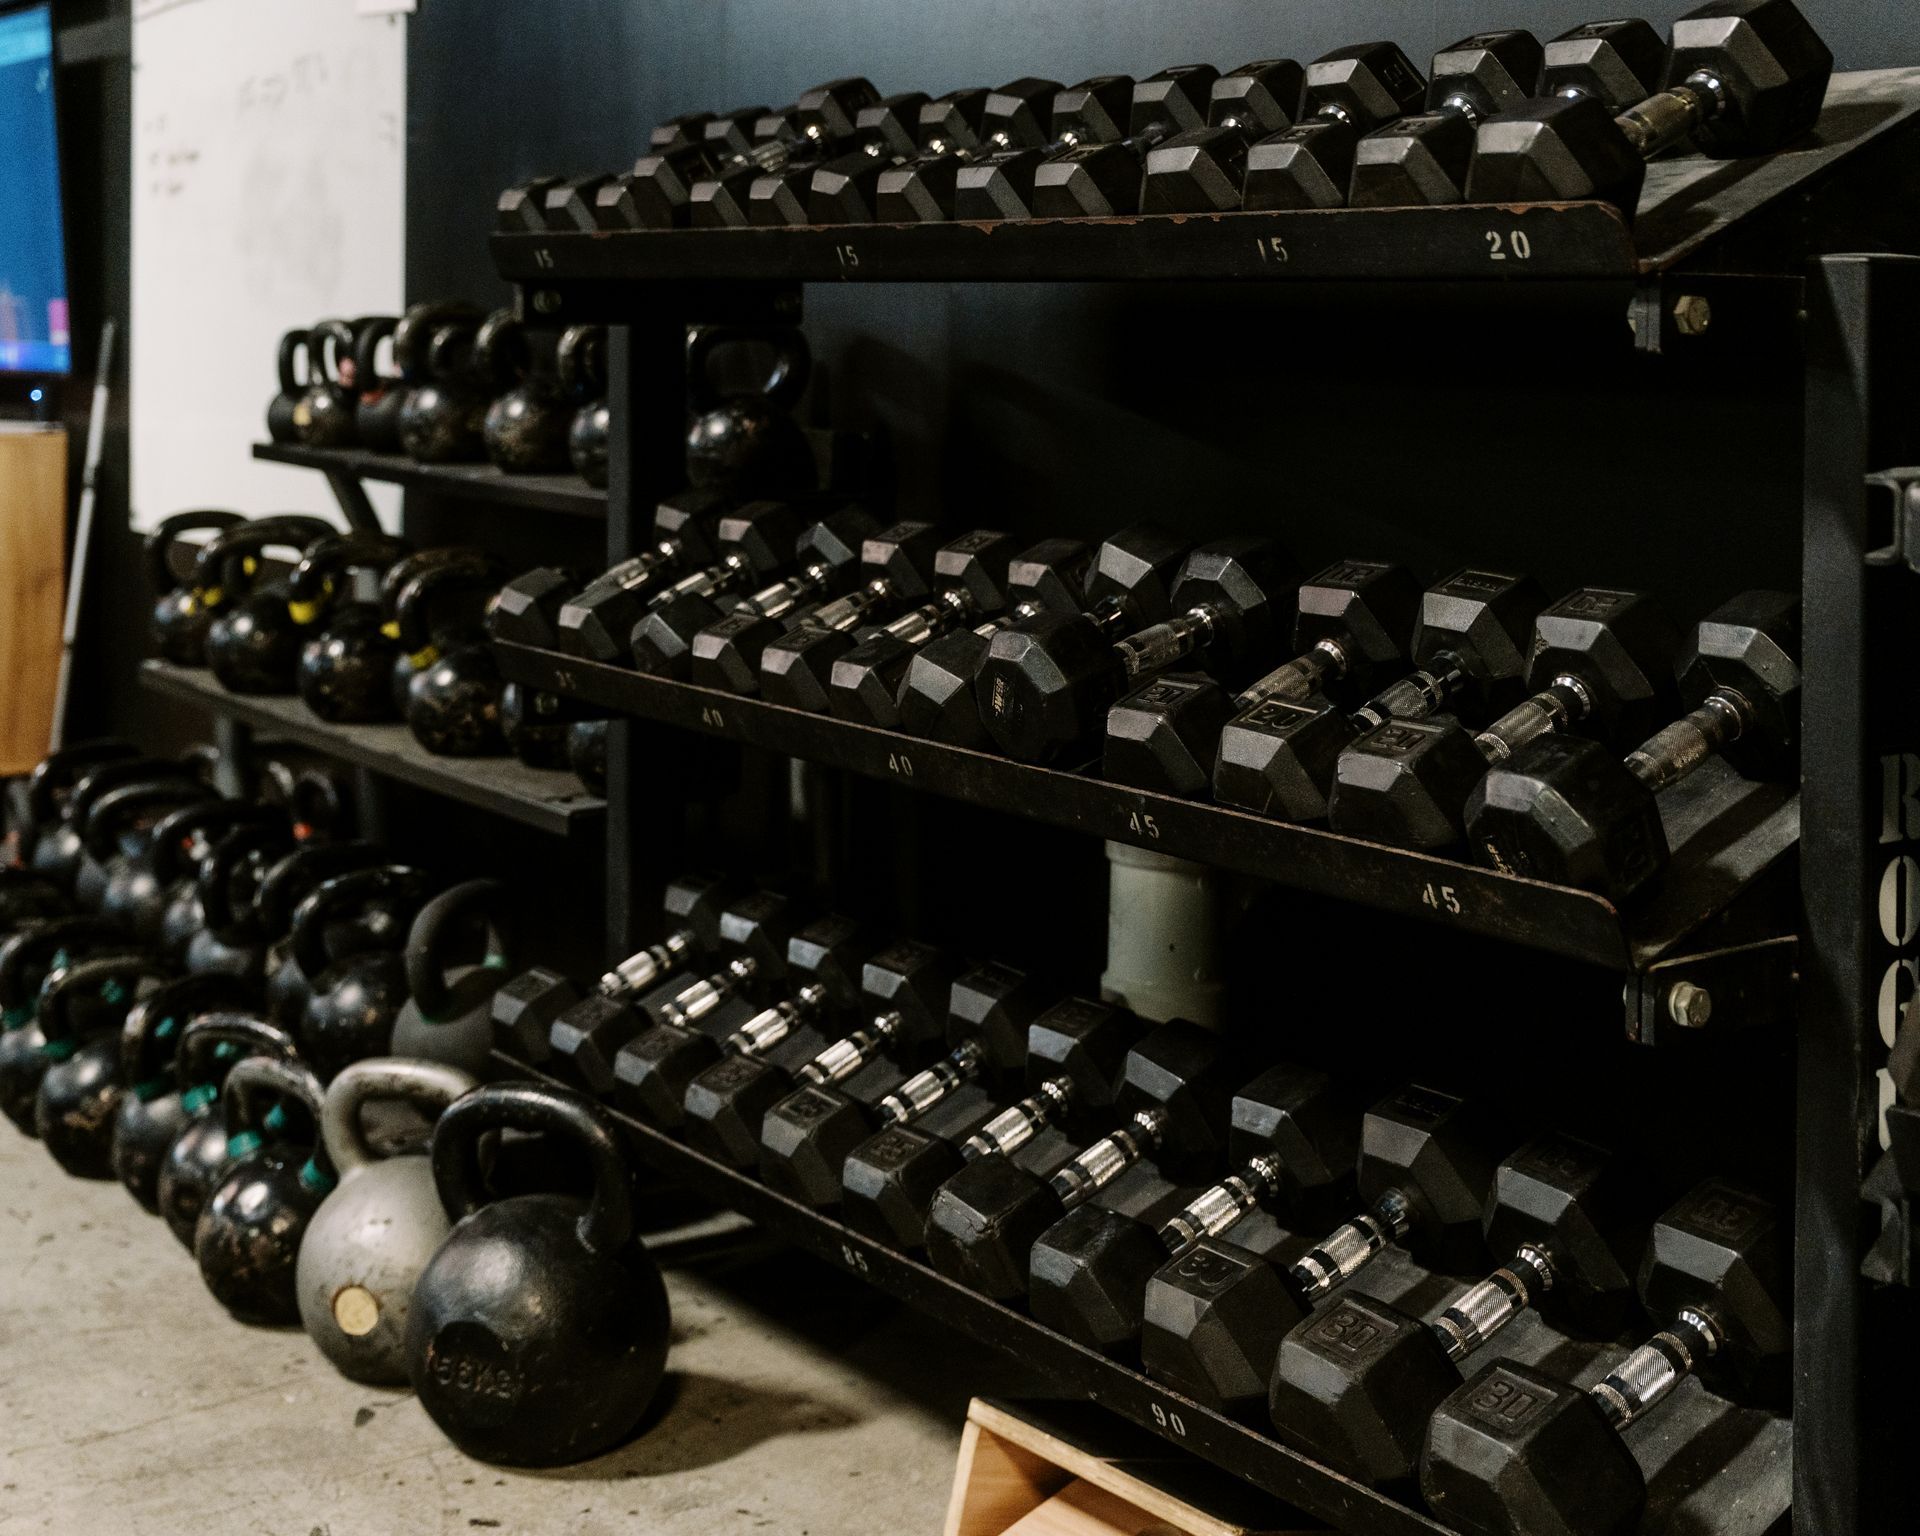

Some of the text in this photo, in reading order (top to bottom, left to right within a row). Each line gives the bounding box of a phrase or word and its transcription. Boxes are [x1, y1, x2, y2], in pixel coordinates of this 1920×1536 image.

[535, 248, 554, 268] 15
[836, 245, 859, 267] 15
[1257, 237, 1288, 265] 15
[1485, 229, 1530, 260] 20
[702, 706, 725, 729] 40
[1247, 706, 1307, 730] 20
[889, 752, 914, 778] 40
[1128, 811, 1160, 840] 45
[1421, 882, 1461, 915] 45
[1178, 1255, 1238, 1288] 30
[1319, 1314, 1382, 1353] 30
[1471, 1380, 1539, 1422] 30
[1151, 1402, 1186, 1437] 90
